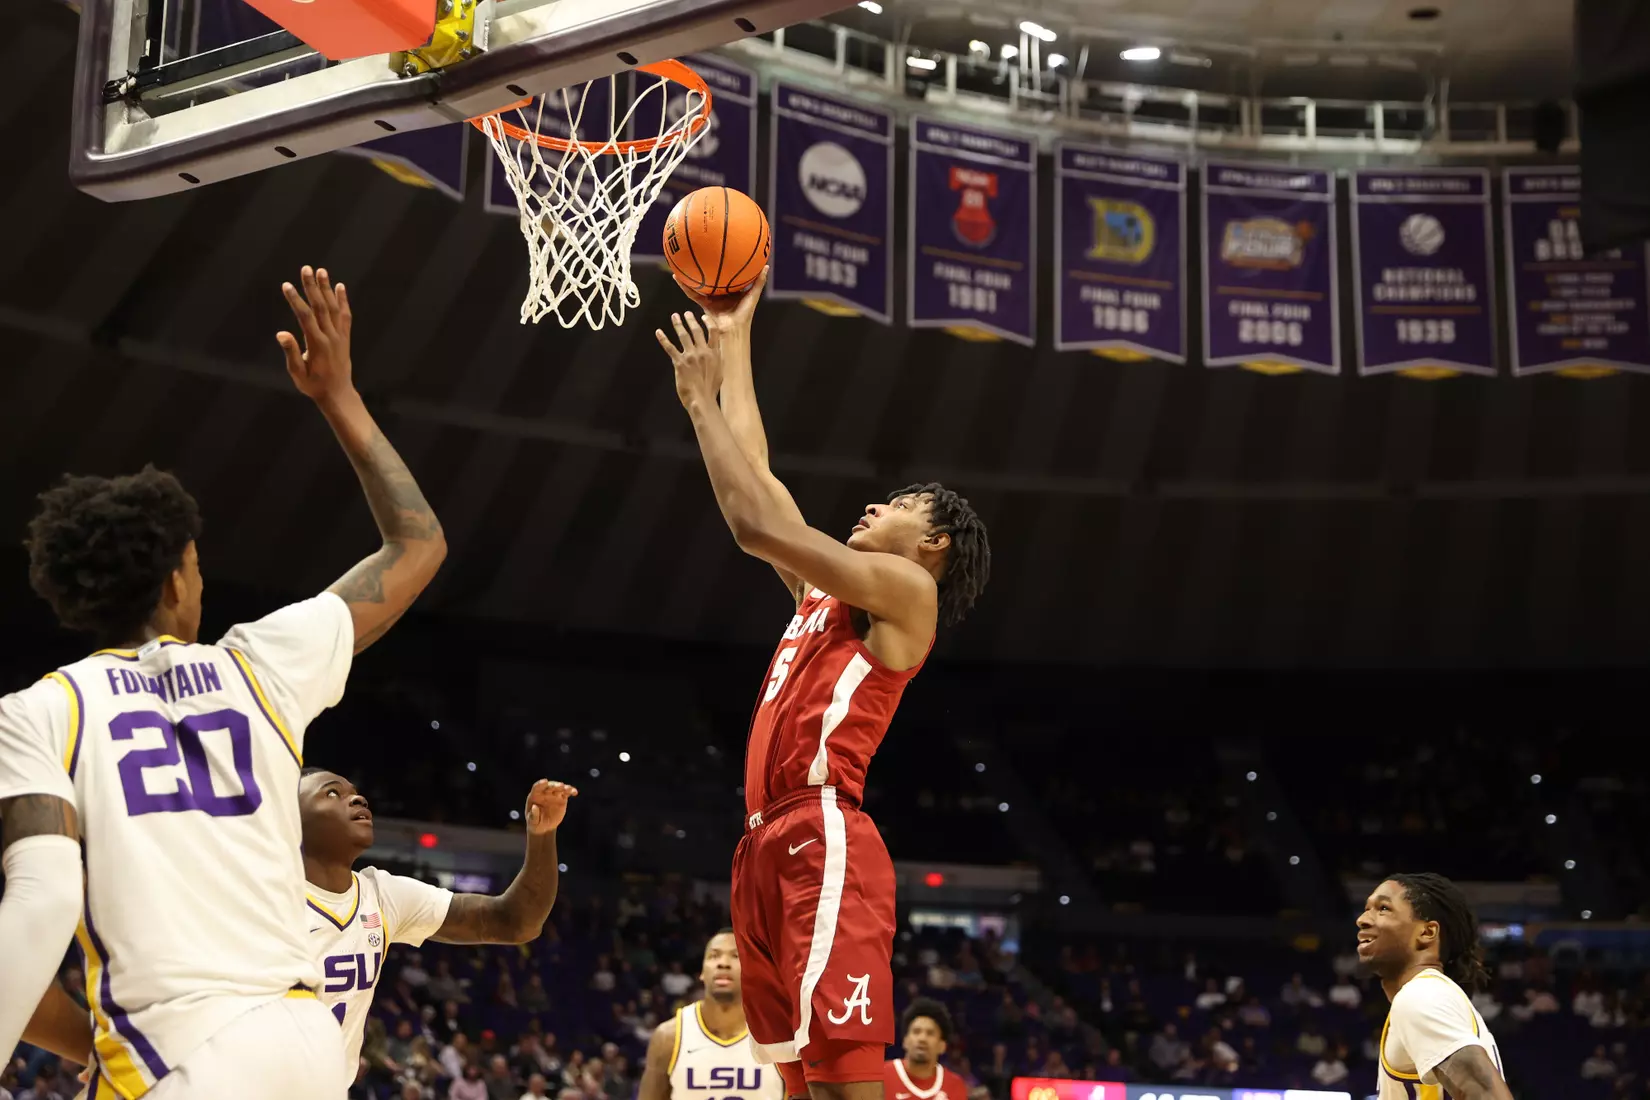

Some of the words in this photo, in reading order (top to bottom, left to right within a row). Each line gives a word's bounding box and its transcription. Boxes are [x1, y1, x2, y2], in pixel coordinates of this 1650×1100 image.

[808, 172, 866, 201] NCAA
[1373, 283, 1477, 302] CHAMPIONS
[1382, 267, 1465, 284] NATIONAL
[105, 661, 223, 704] FOUNTAIN
[108, 708, 263, 817] 20
[324, 952, 382, 992] SU
[827, 973, 873, 1026] A
[687, 1067, 761, 1090] LSU
